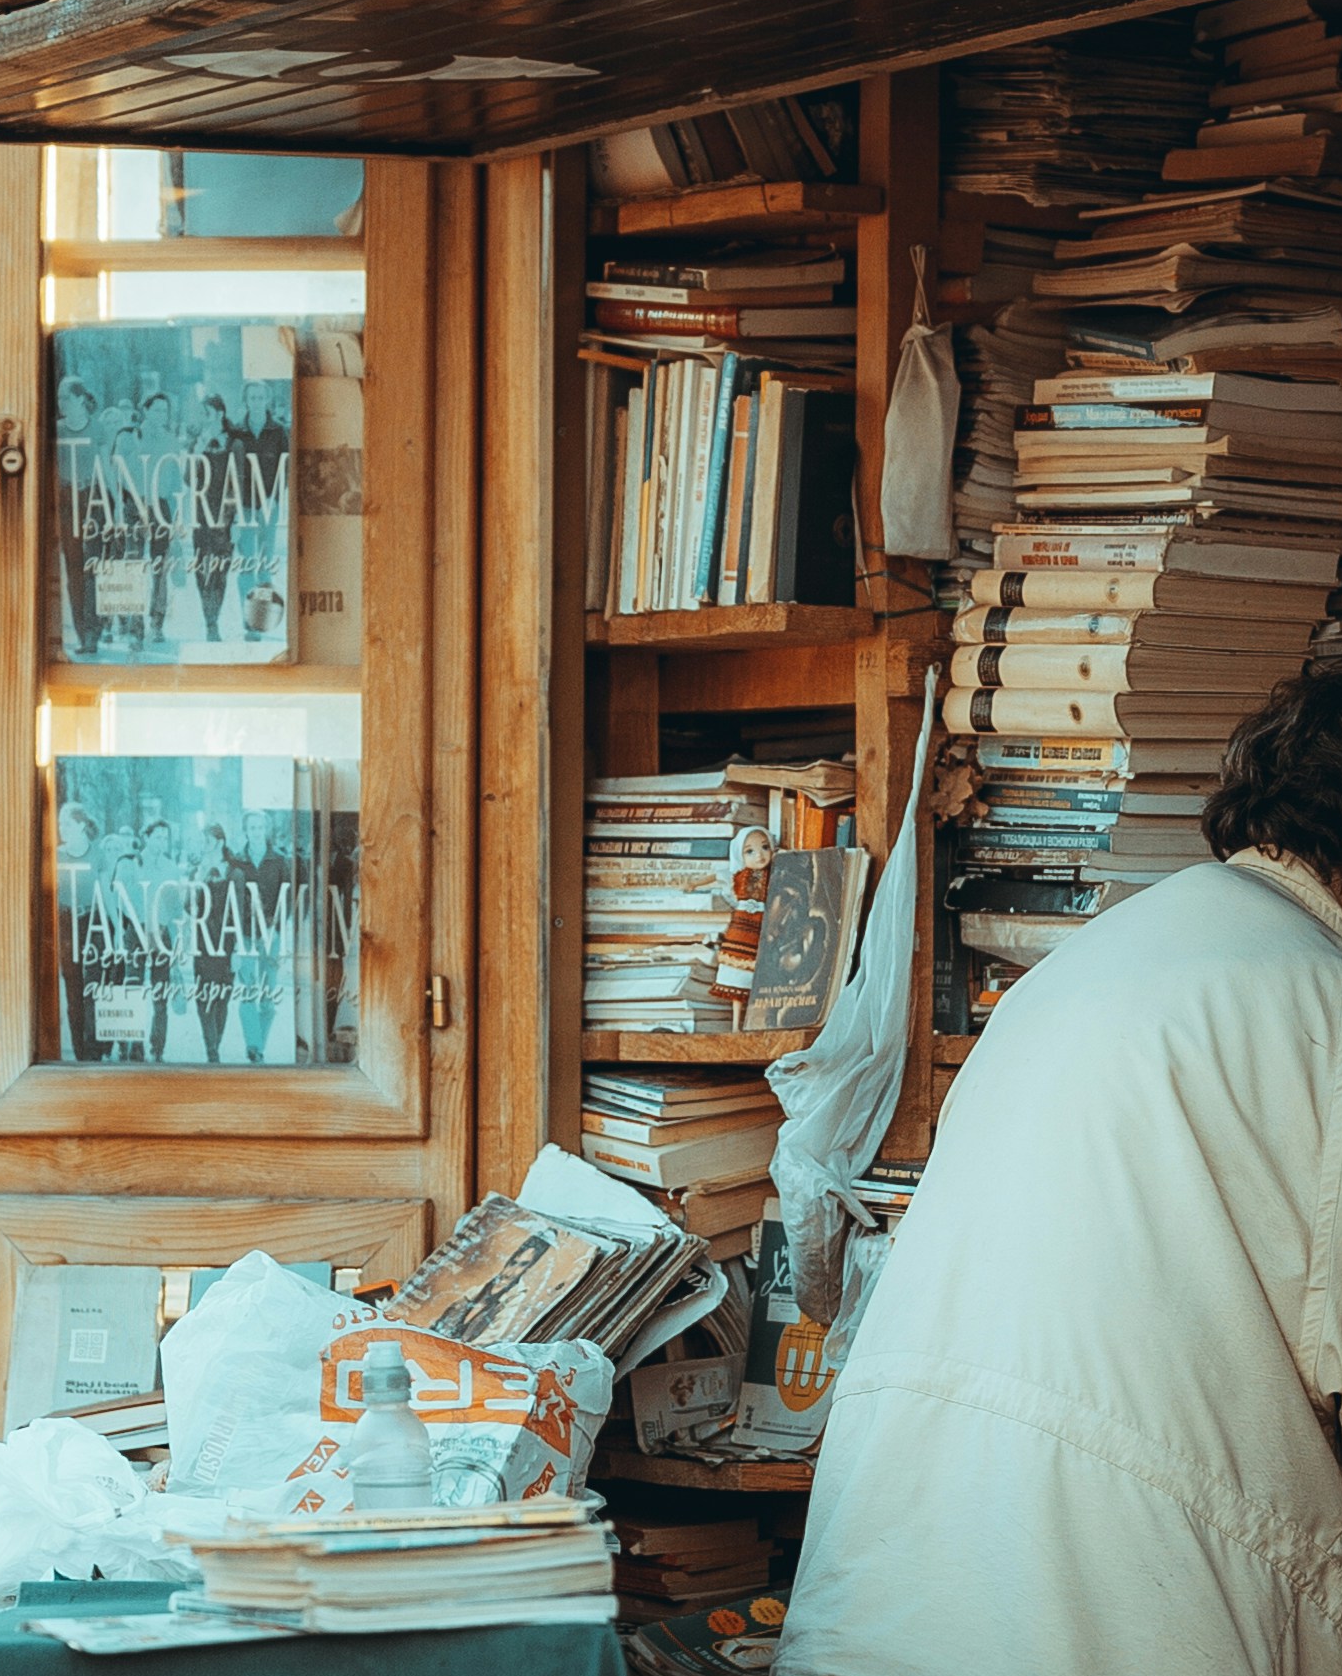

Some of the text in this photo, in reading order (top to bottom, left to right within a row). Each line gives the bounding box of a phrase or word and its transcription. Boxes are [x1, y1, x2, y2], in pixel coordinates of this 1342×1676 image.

[57, 437, 290, 539] TANGRAM
[81, 519, 188, 544] Deutsch
[297, 589, 345, 617] урата
[55, 862, 292, 964] TANGRAM
[81, 944, 188, 969] Deutsch
[82, 978, 285, 1013] als Fremdsprache
[335, 1359, 539, 1411] ERO
